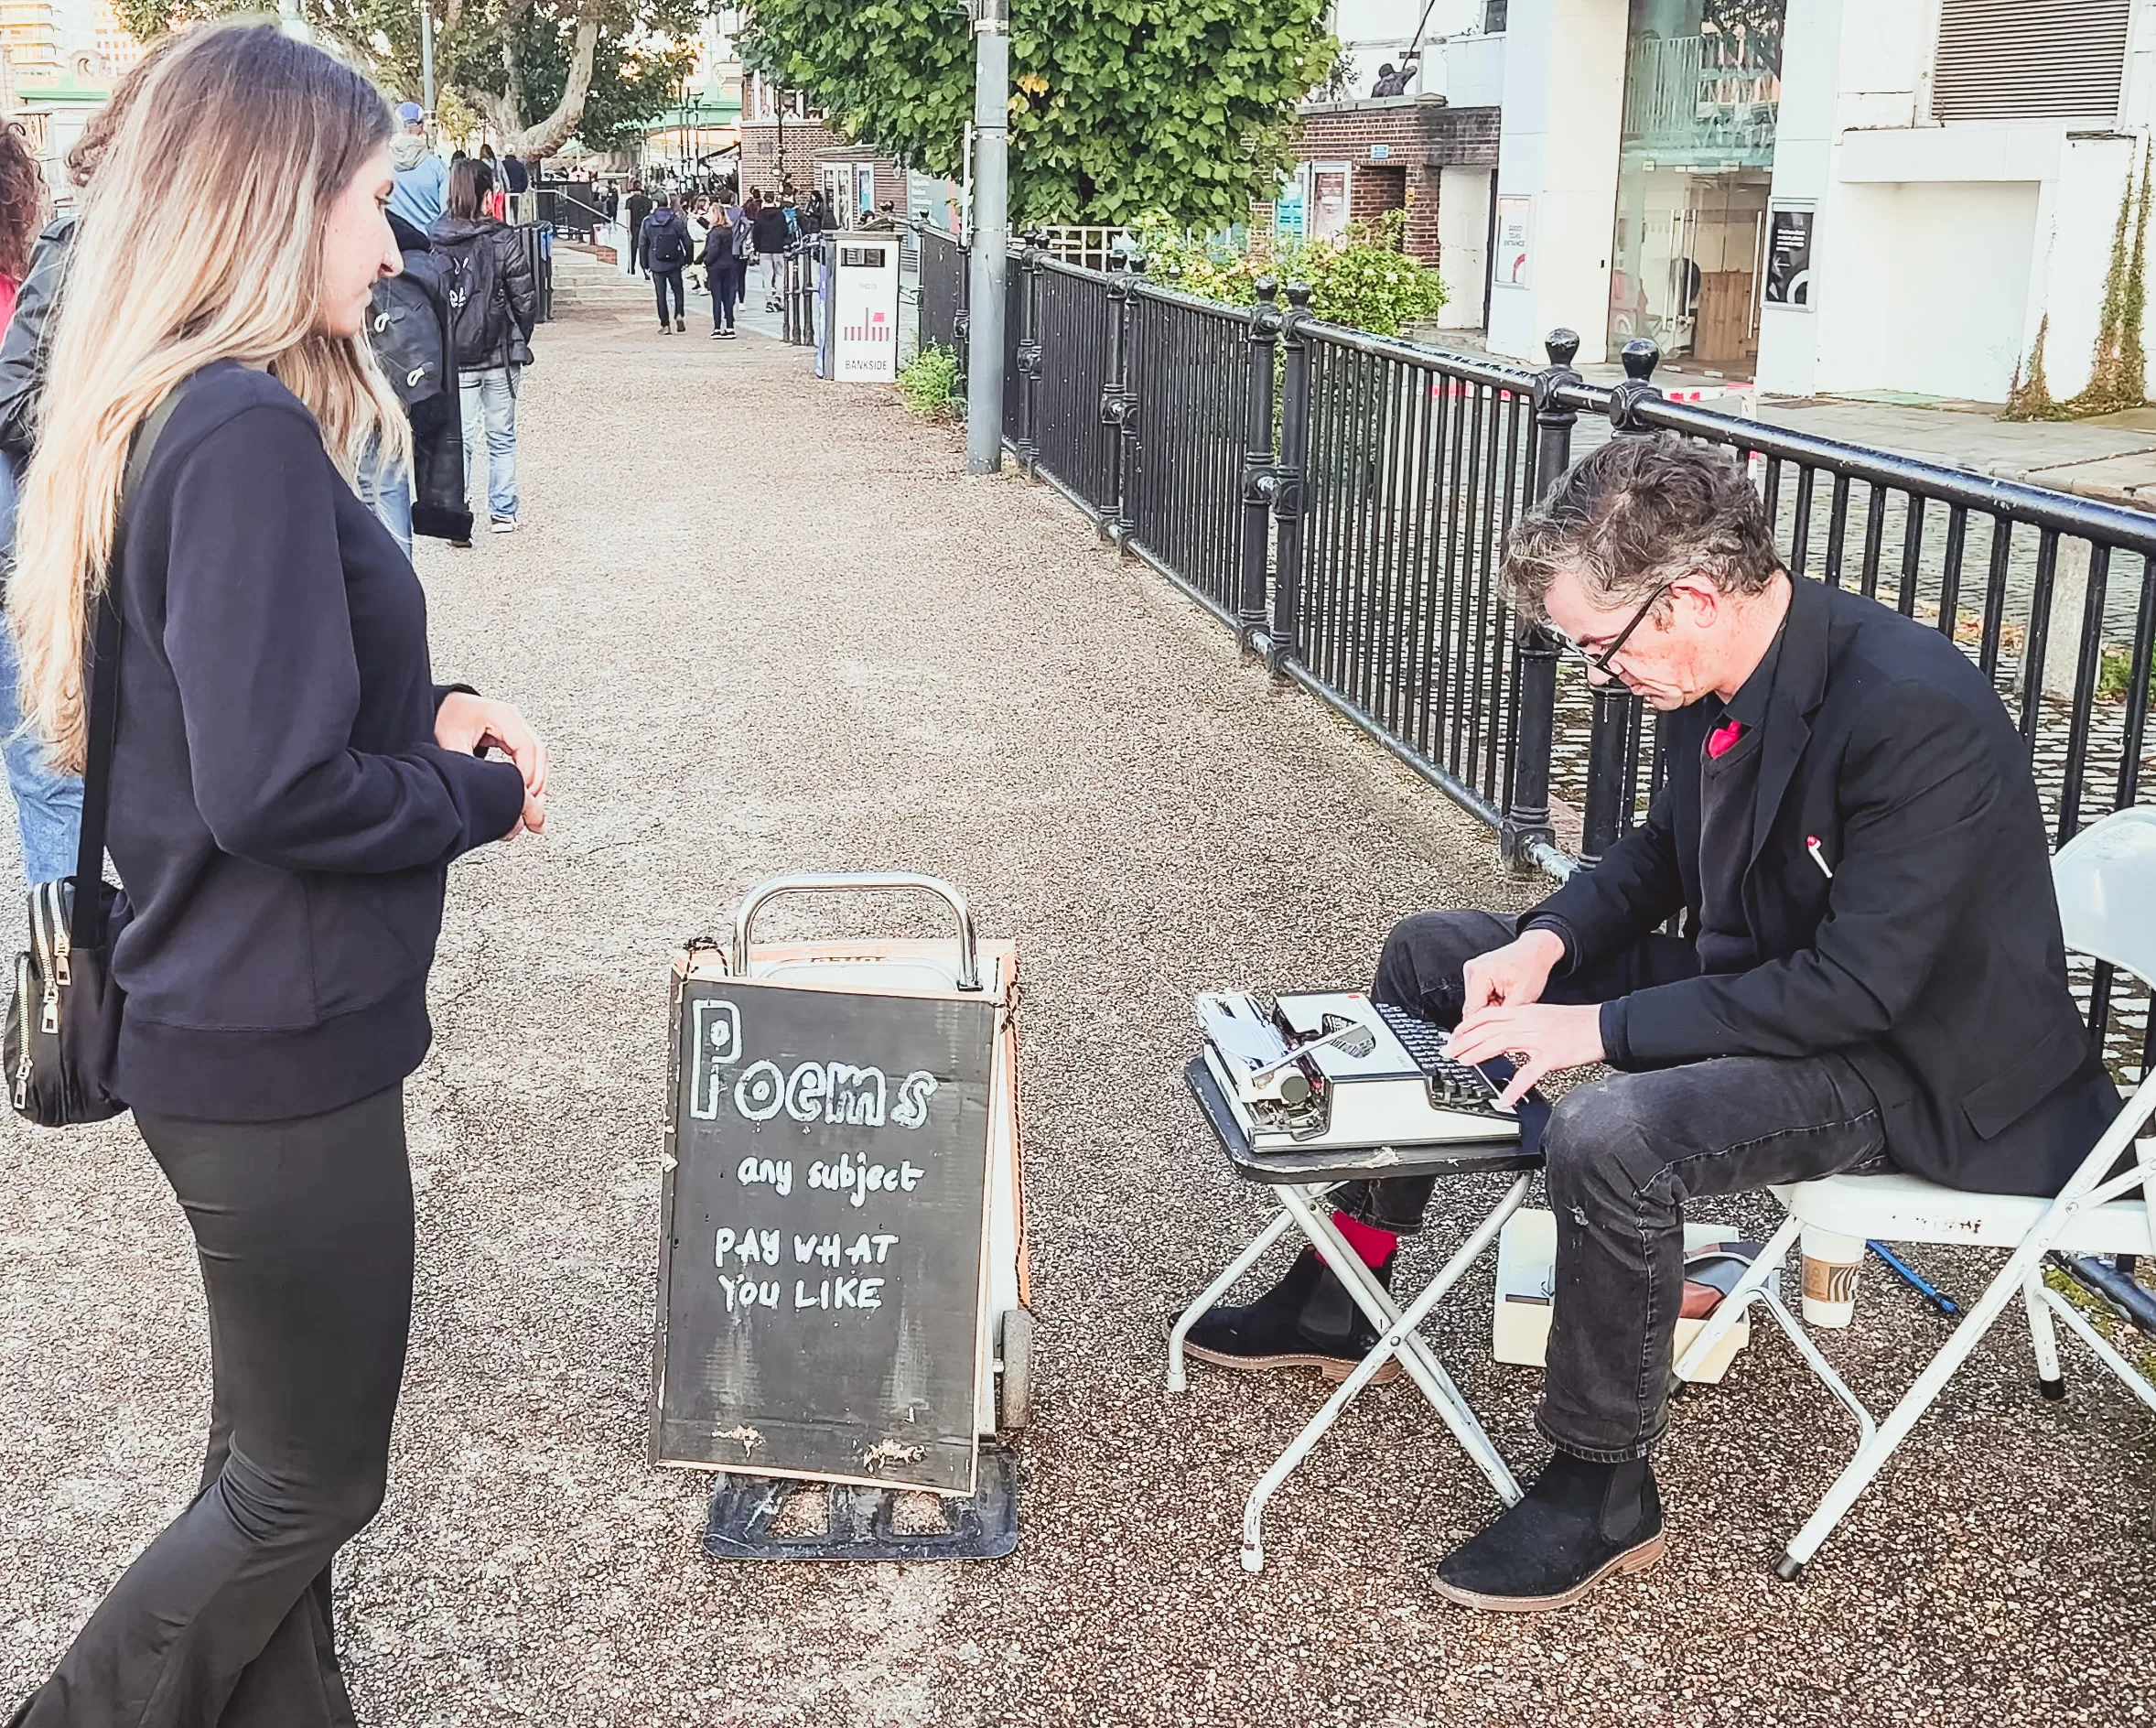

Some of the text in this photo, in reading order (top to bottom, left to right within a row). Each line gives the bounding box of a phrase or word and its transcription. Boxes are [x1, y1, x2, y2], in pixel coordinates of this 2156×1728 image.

[845, 360, 888, 371] BANKSIDE
[690, 999, 939, 1129] Poems
[737, 1151, 926, 1208] any subject
[715, 1226, 900, 1268] PAY WHAT
[793, 1276, 886, 1311] LIKE
